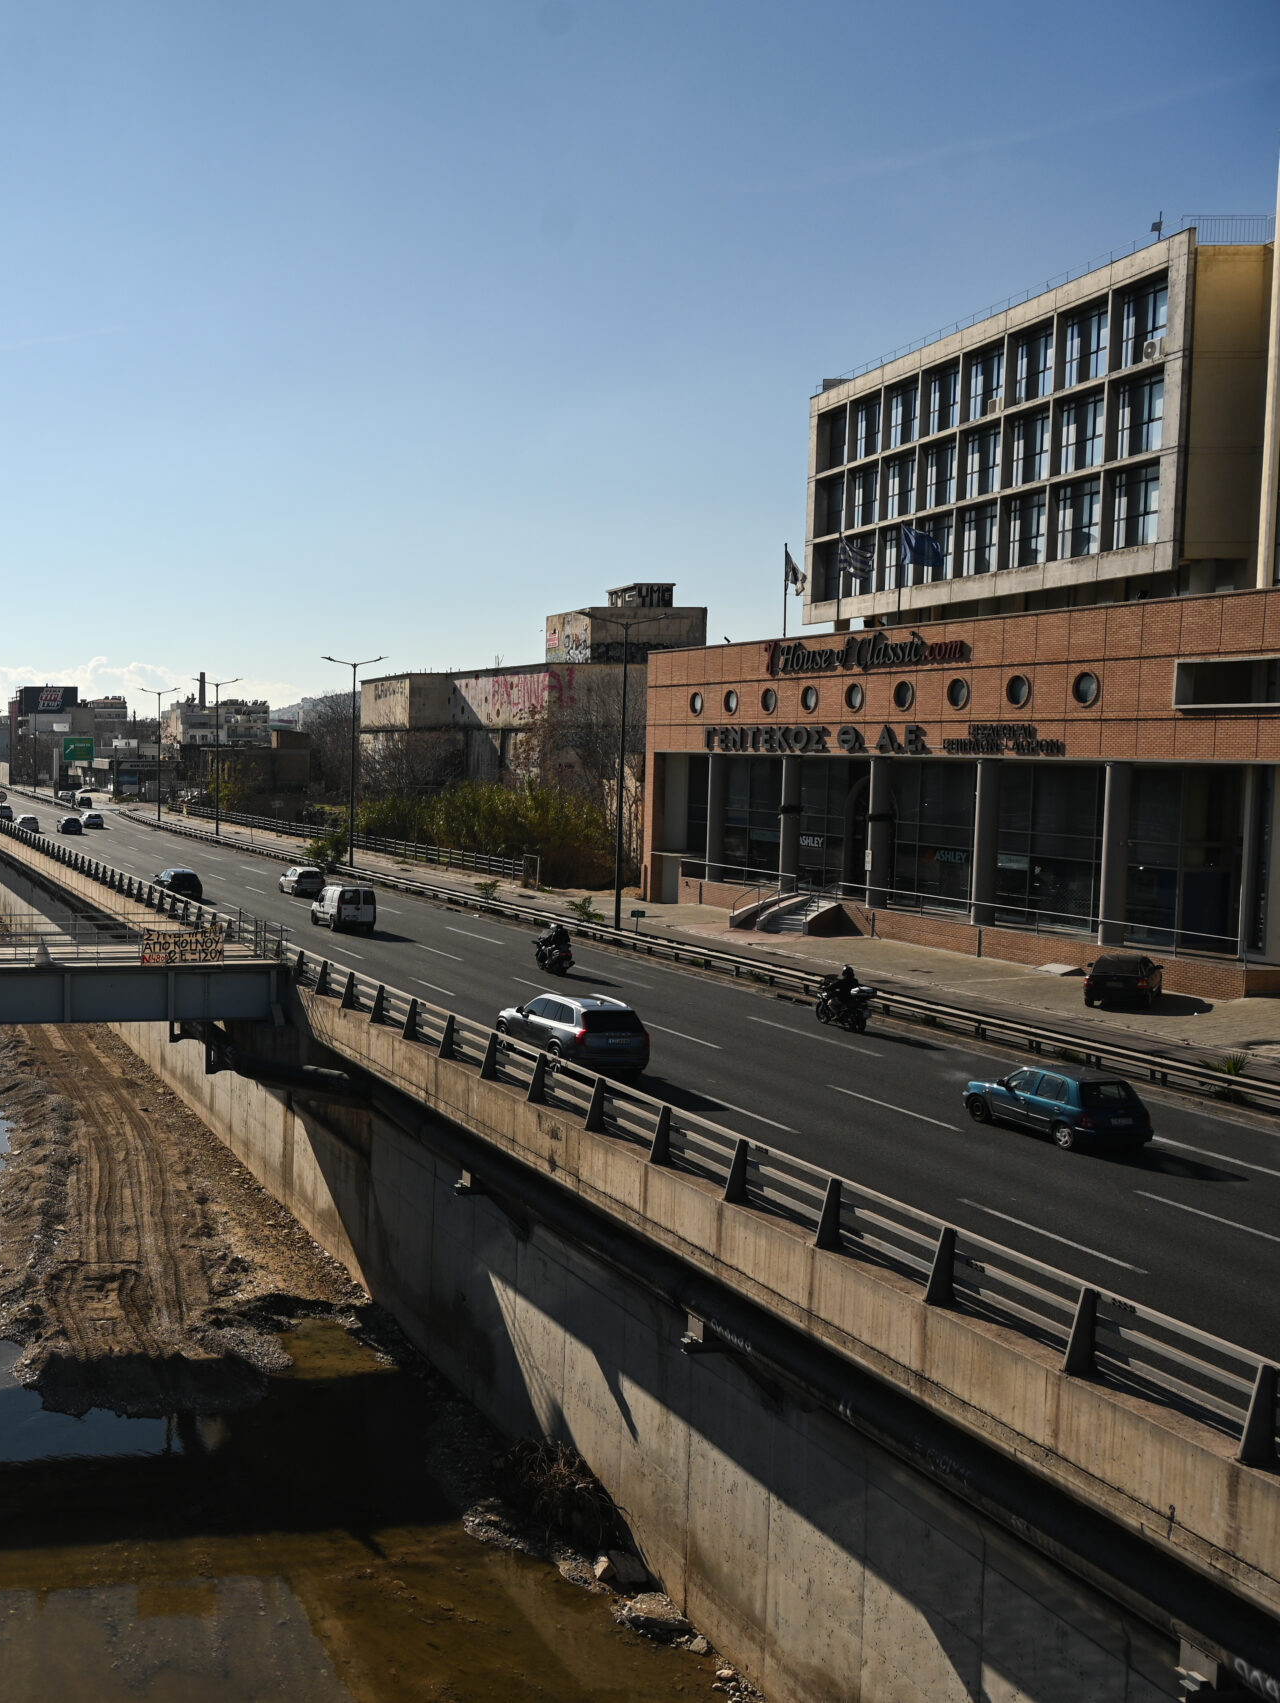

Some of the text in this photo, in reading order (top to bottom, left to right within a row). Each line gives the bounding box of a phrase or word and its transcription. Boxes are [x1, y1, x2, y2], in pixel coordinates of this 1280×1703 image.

[778, 640, 832, 673] House
[704, 725, 826, 751] ΓΕΝΤΕΚΟΣ
[935, 849, 968, 864] ASHLEY
[143, 936, 221, 953] ΑΠΟ ΚΟΙΝΟΥ
[180, 947, 223, 962] ΕΞΙΣΟΥ
